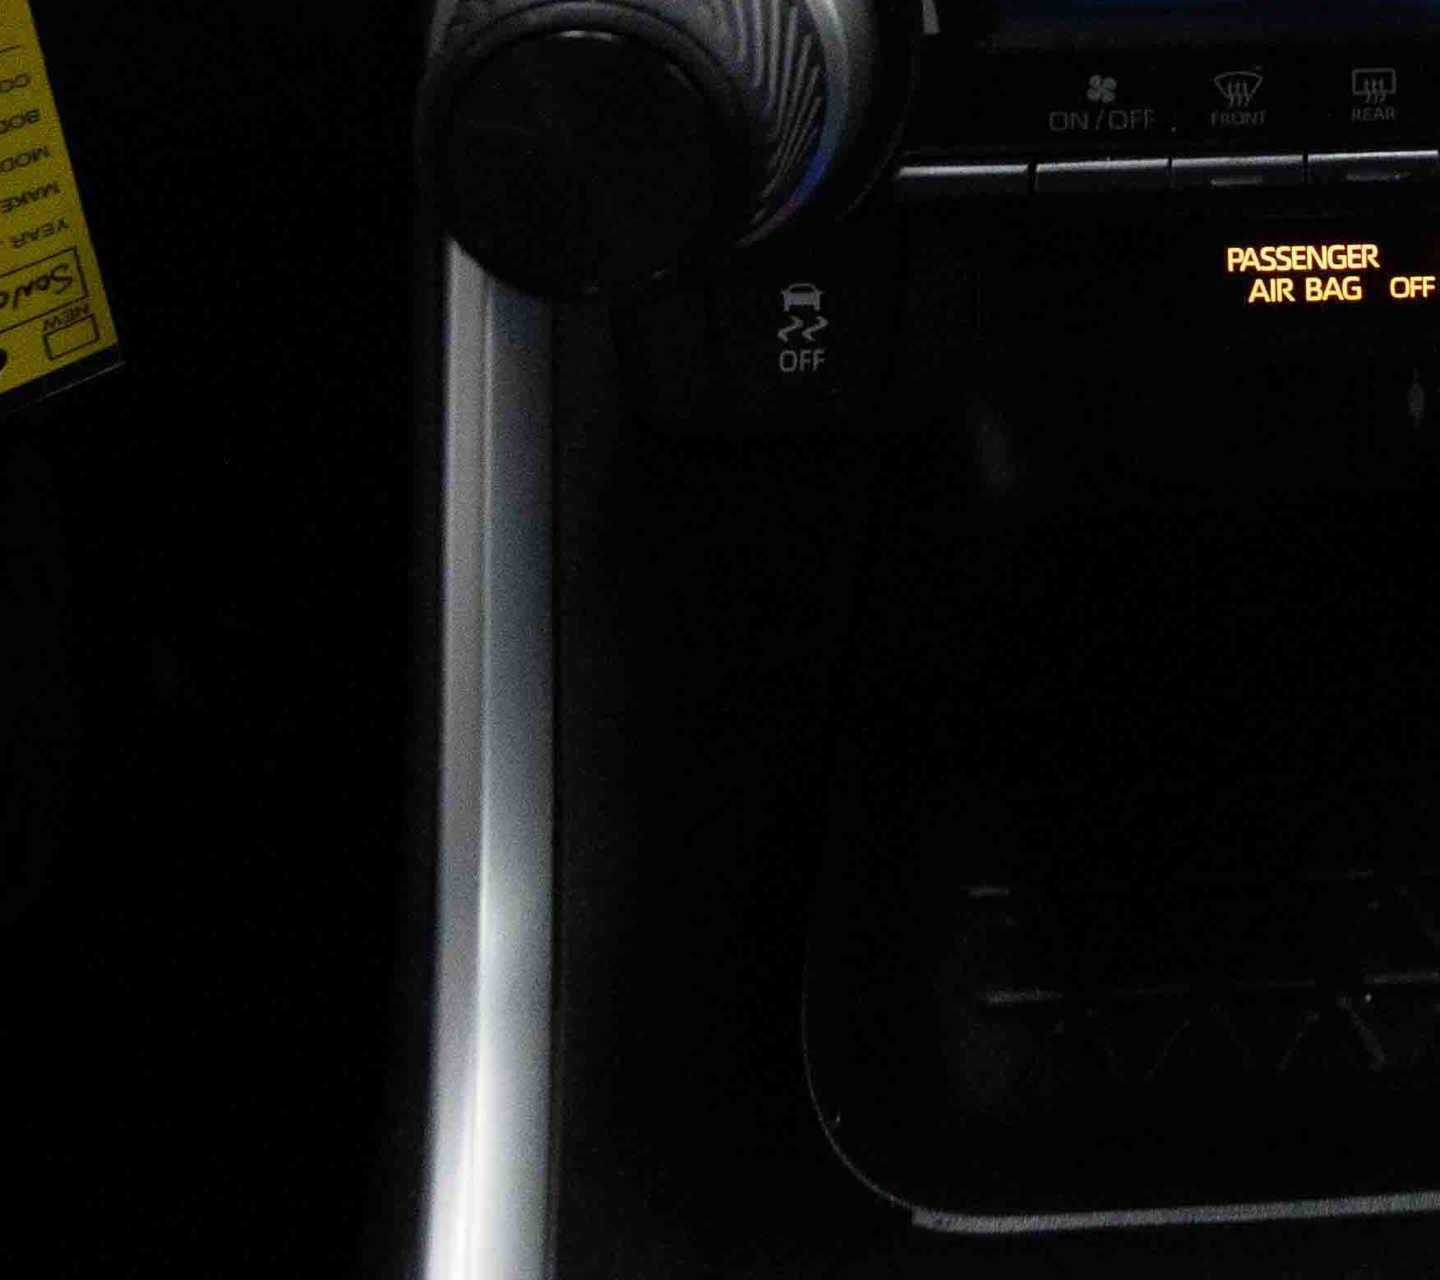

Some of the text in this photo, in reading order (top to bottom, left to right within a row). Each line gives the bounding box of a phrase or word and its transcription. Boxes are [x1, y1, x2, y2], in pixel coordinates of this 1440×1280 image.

[1048, 108, 1157, 132] ON/OFF
[1210, 109, 1267, 127] FRONT
[1351, 106, 1396, 123] REAR
[0, 181, 62, 214] MAKE
[11, 218, 70, 250] YEAR
[1227, 243, 1381, 272] PASSENGER
[1248, 275, 1436, 303] AIR BAG OFF
[43, 304, 90, 331] NEW
[778, 348, 828, 373] OFF
